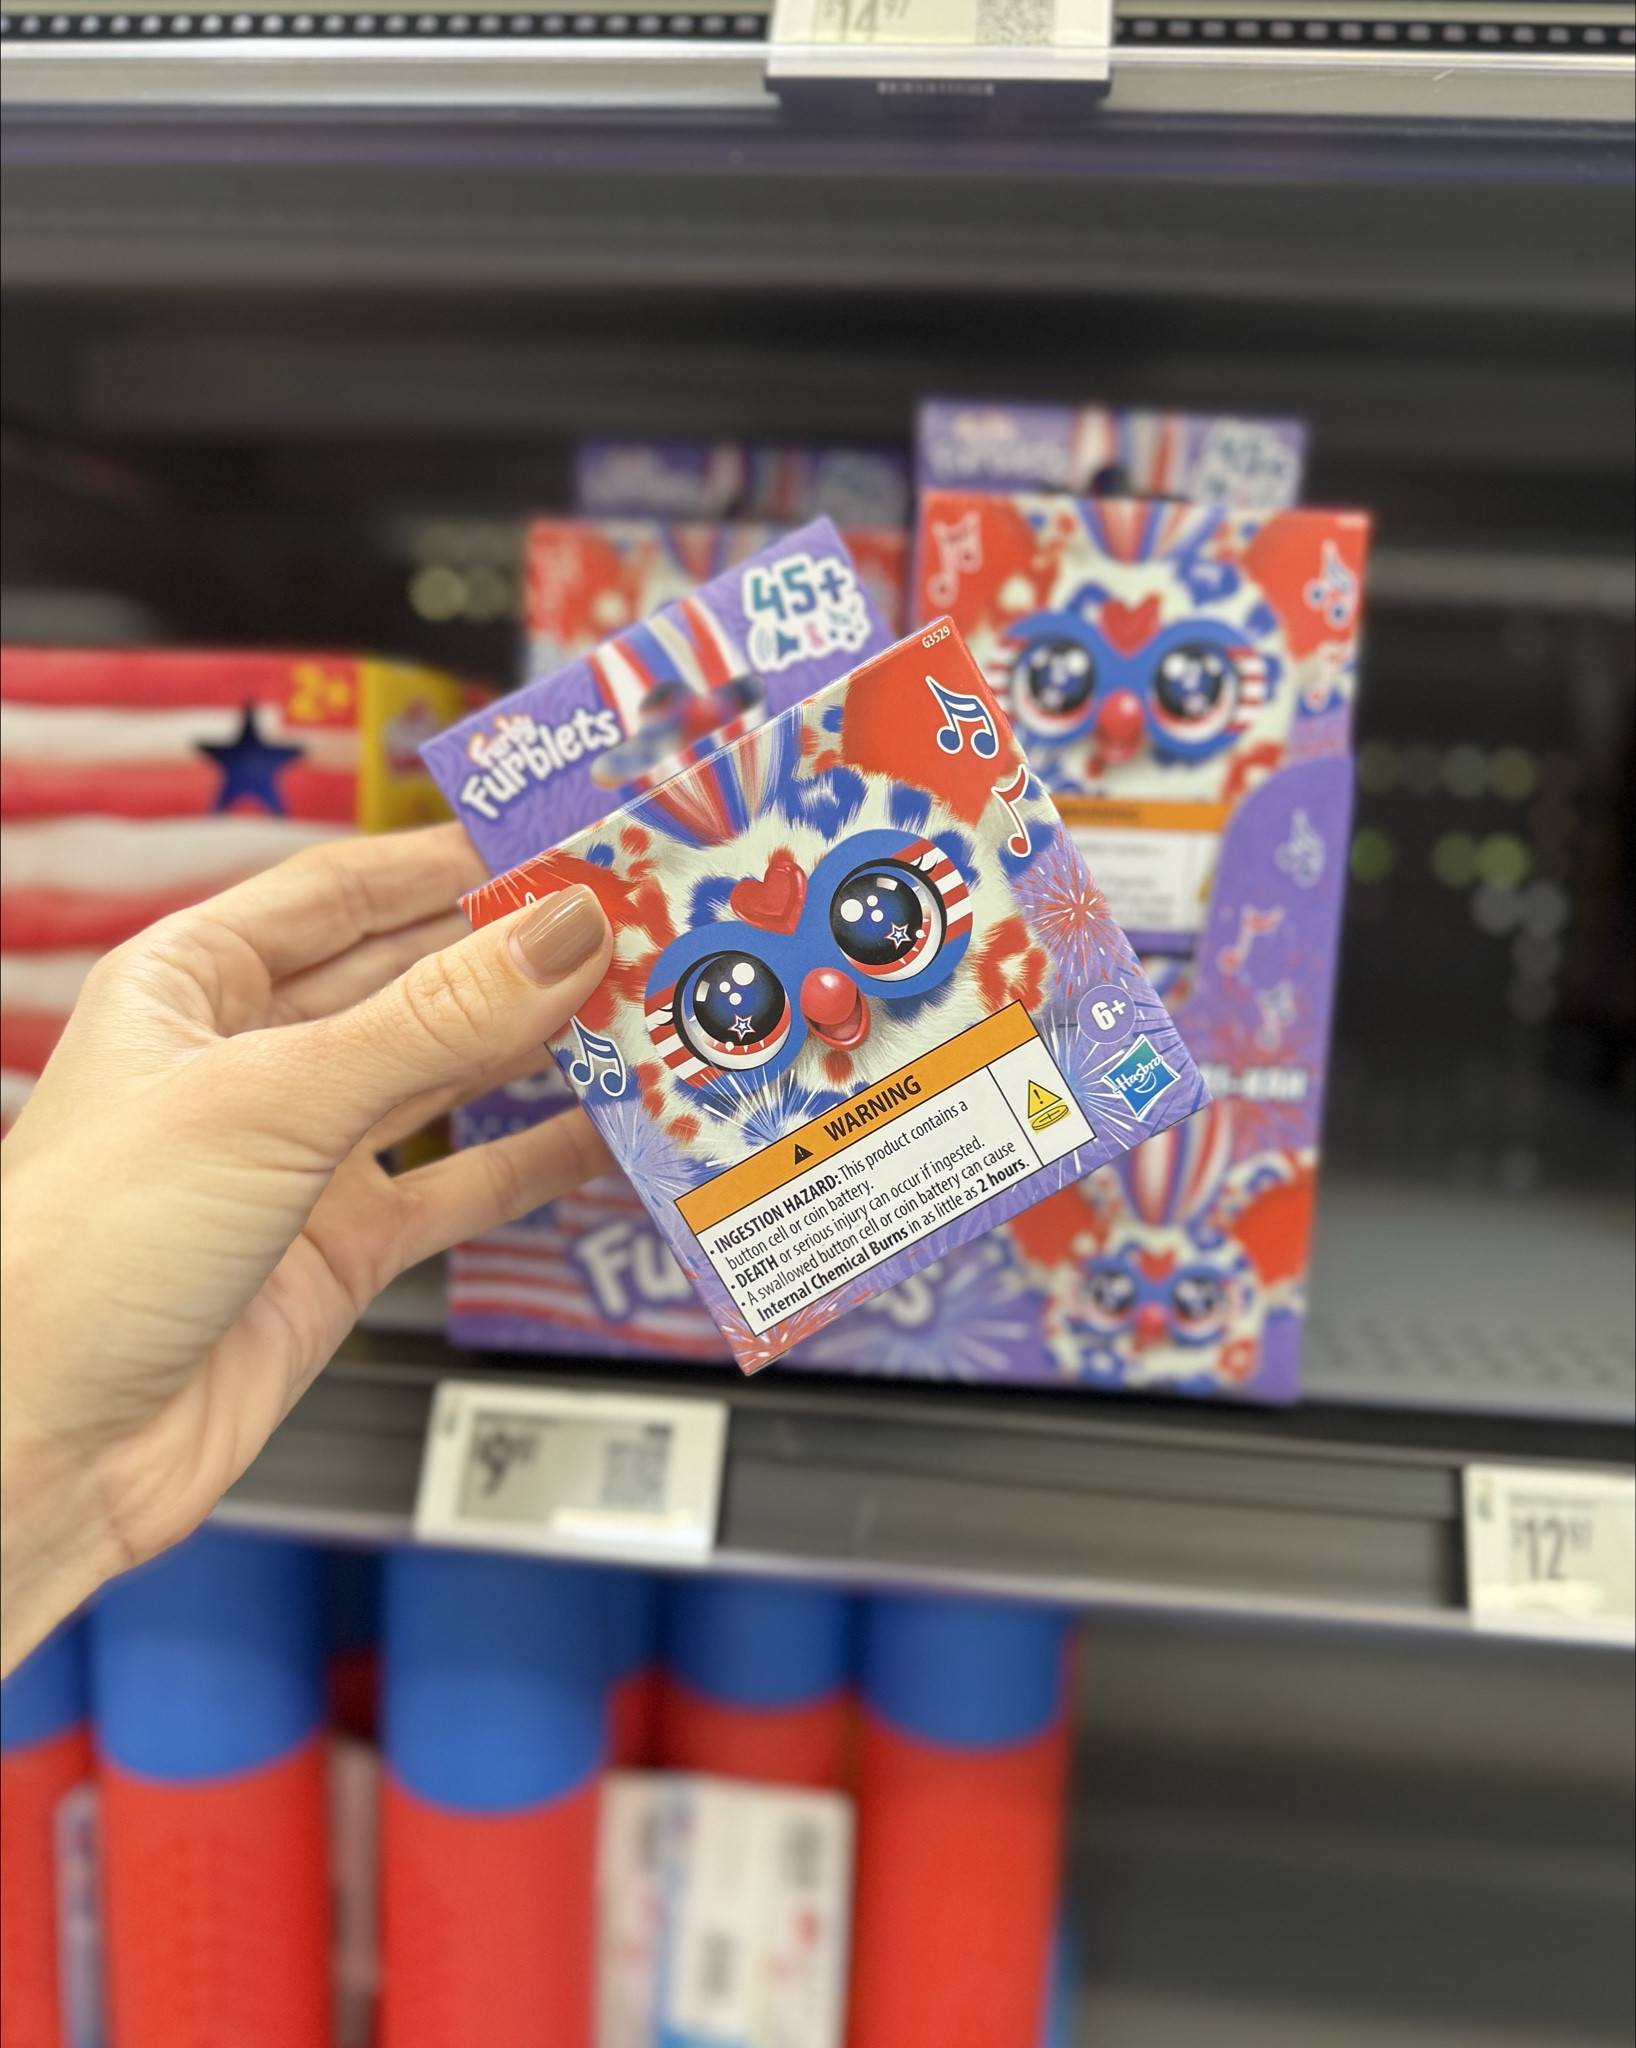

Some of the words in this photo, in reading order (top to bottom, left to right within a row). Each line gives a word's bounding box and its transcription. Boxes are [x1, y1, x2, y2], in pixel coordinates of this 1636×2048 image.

[751, 562, 846, 621] 45+
[921, 625, 951, 649] G3529
[460, 707, 621, 819] Furblets
[1091, 999, 1126, 1031] 6+
[822, 1074, 922, 1142] WARNING
[1112, 1054, 1164, 1094] Hasbro
[714, 1204, 785, 1254] INGESTION
[782, 1174, 842, 1214] HAZARD:
[837, 1160, 866, 1181] This
[864, 1132, 912, 1171] product
[910, 1105, 959, 1140] contains
[958, 1100, 969, 1112] a
[734, 1254, 779, 1288] DEATH
[779, 1248, 793, 1263] or
[792, 1225, 834, 1256] serious
[831, 1204, 868, 1232] injury
[869, 1192, 891, 1211] can
[890, 1173, 921, 1198] occur
[919, 1163, 932, 1180] if
[929, 1135, 985, 1174] ingested.
[725, 1241, 768, 1271] button
[768, 1225, 790, 1247] cell
[789, 1219, 802, 1234] or
[803, 1206, 829, 1226] coin
[825, 1180, 874, 1212] battery.
[747, 1291, 759, 1306] A
[757, 1253, 820, 1300] swallowed
[816, 1234, 859, 1263] button
[859, 1217, 880, 1240] cell
[880, 1212, 893, 1227] or
[894, 1199, 919, 1219] coin
[916, 1173, 960, 1205] battery
[961, 1161, 983, 1180] can
[983, 1142, 1016, 1167] cause
[756, 1281, 812, 1322] Internal
[810, 1246, 871, 1290] Chemical
[868, 1227, 909, 1256] Burns
[906, 1220, 922, 1234] in
[921, 1211, 936, 1226] as
[933, 1195, 964, 1218] little
[963, 1186, 979, 1201] as
[976, 1178, 989, 1193] 2
[986, 1158, 1030, 1187] hours.
